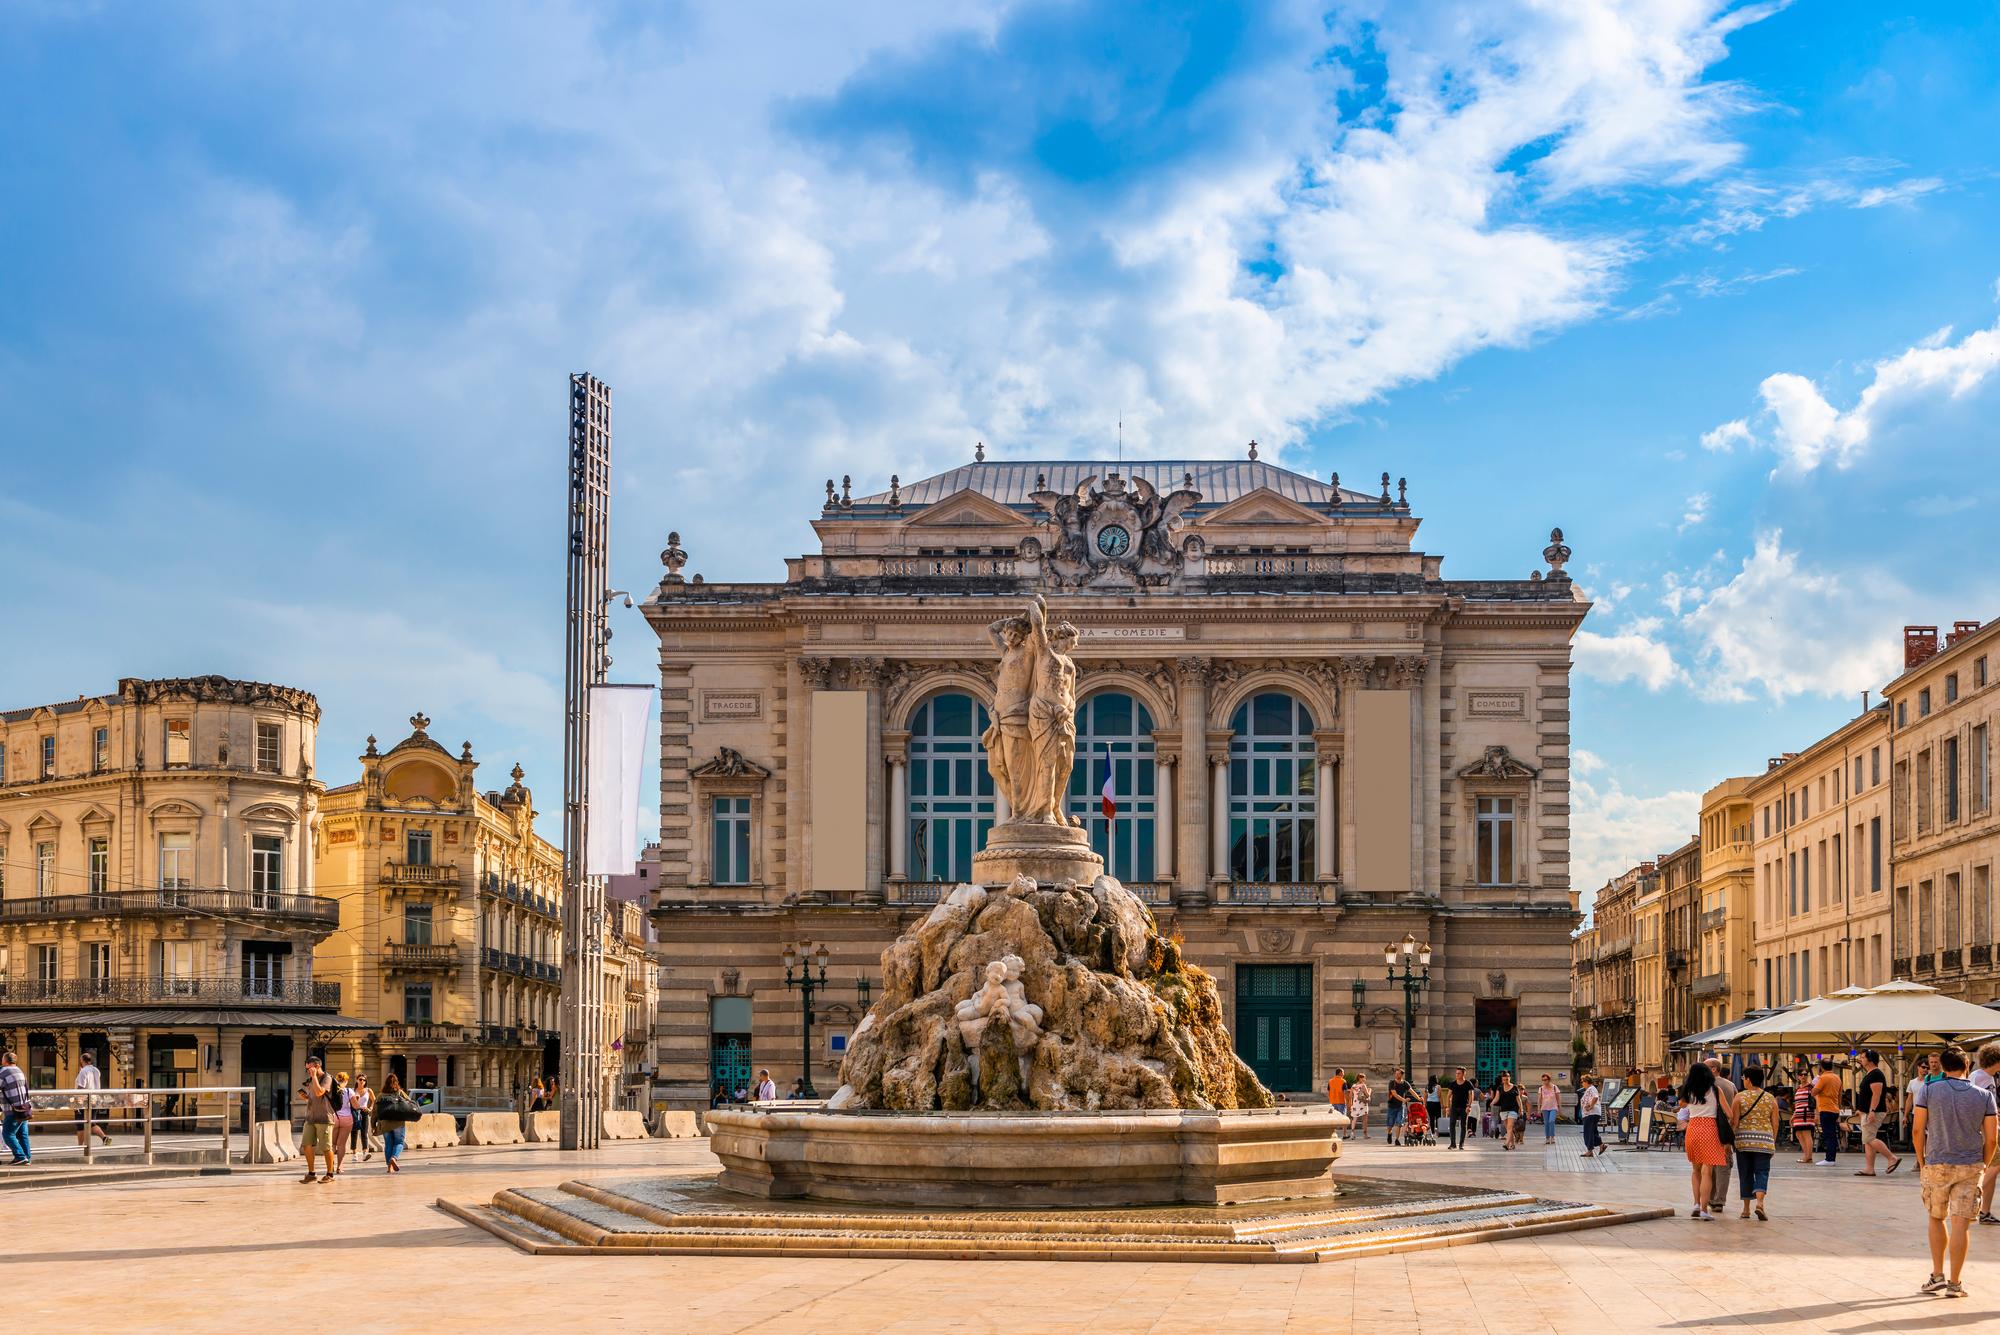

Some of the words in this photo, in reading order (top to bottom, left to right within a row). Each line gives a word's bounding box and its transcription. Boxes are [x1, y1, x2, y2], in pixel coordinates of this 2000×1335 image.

[1079, 628, 1095, 637] RA
[1113, 628, 1168, 637] COMEDIE
[1476, 700, 1516, 708] COMEDIE
